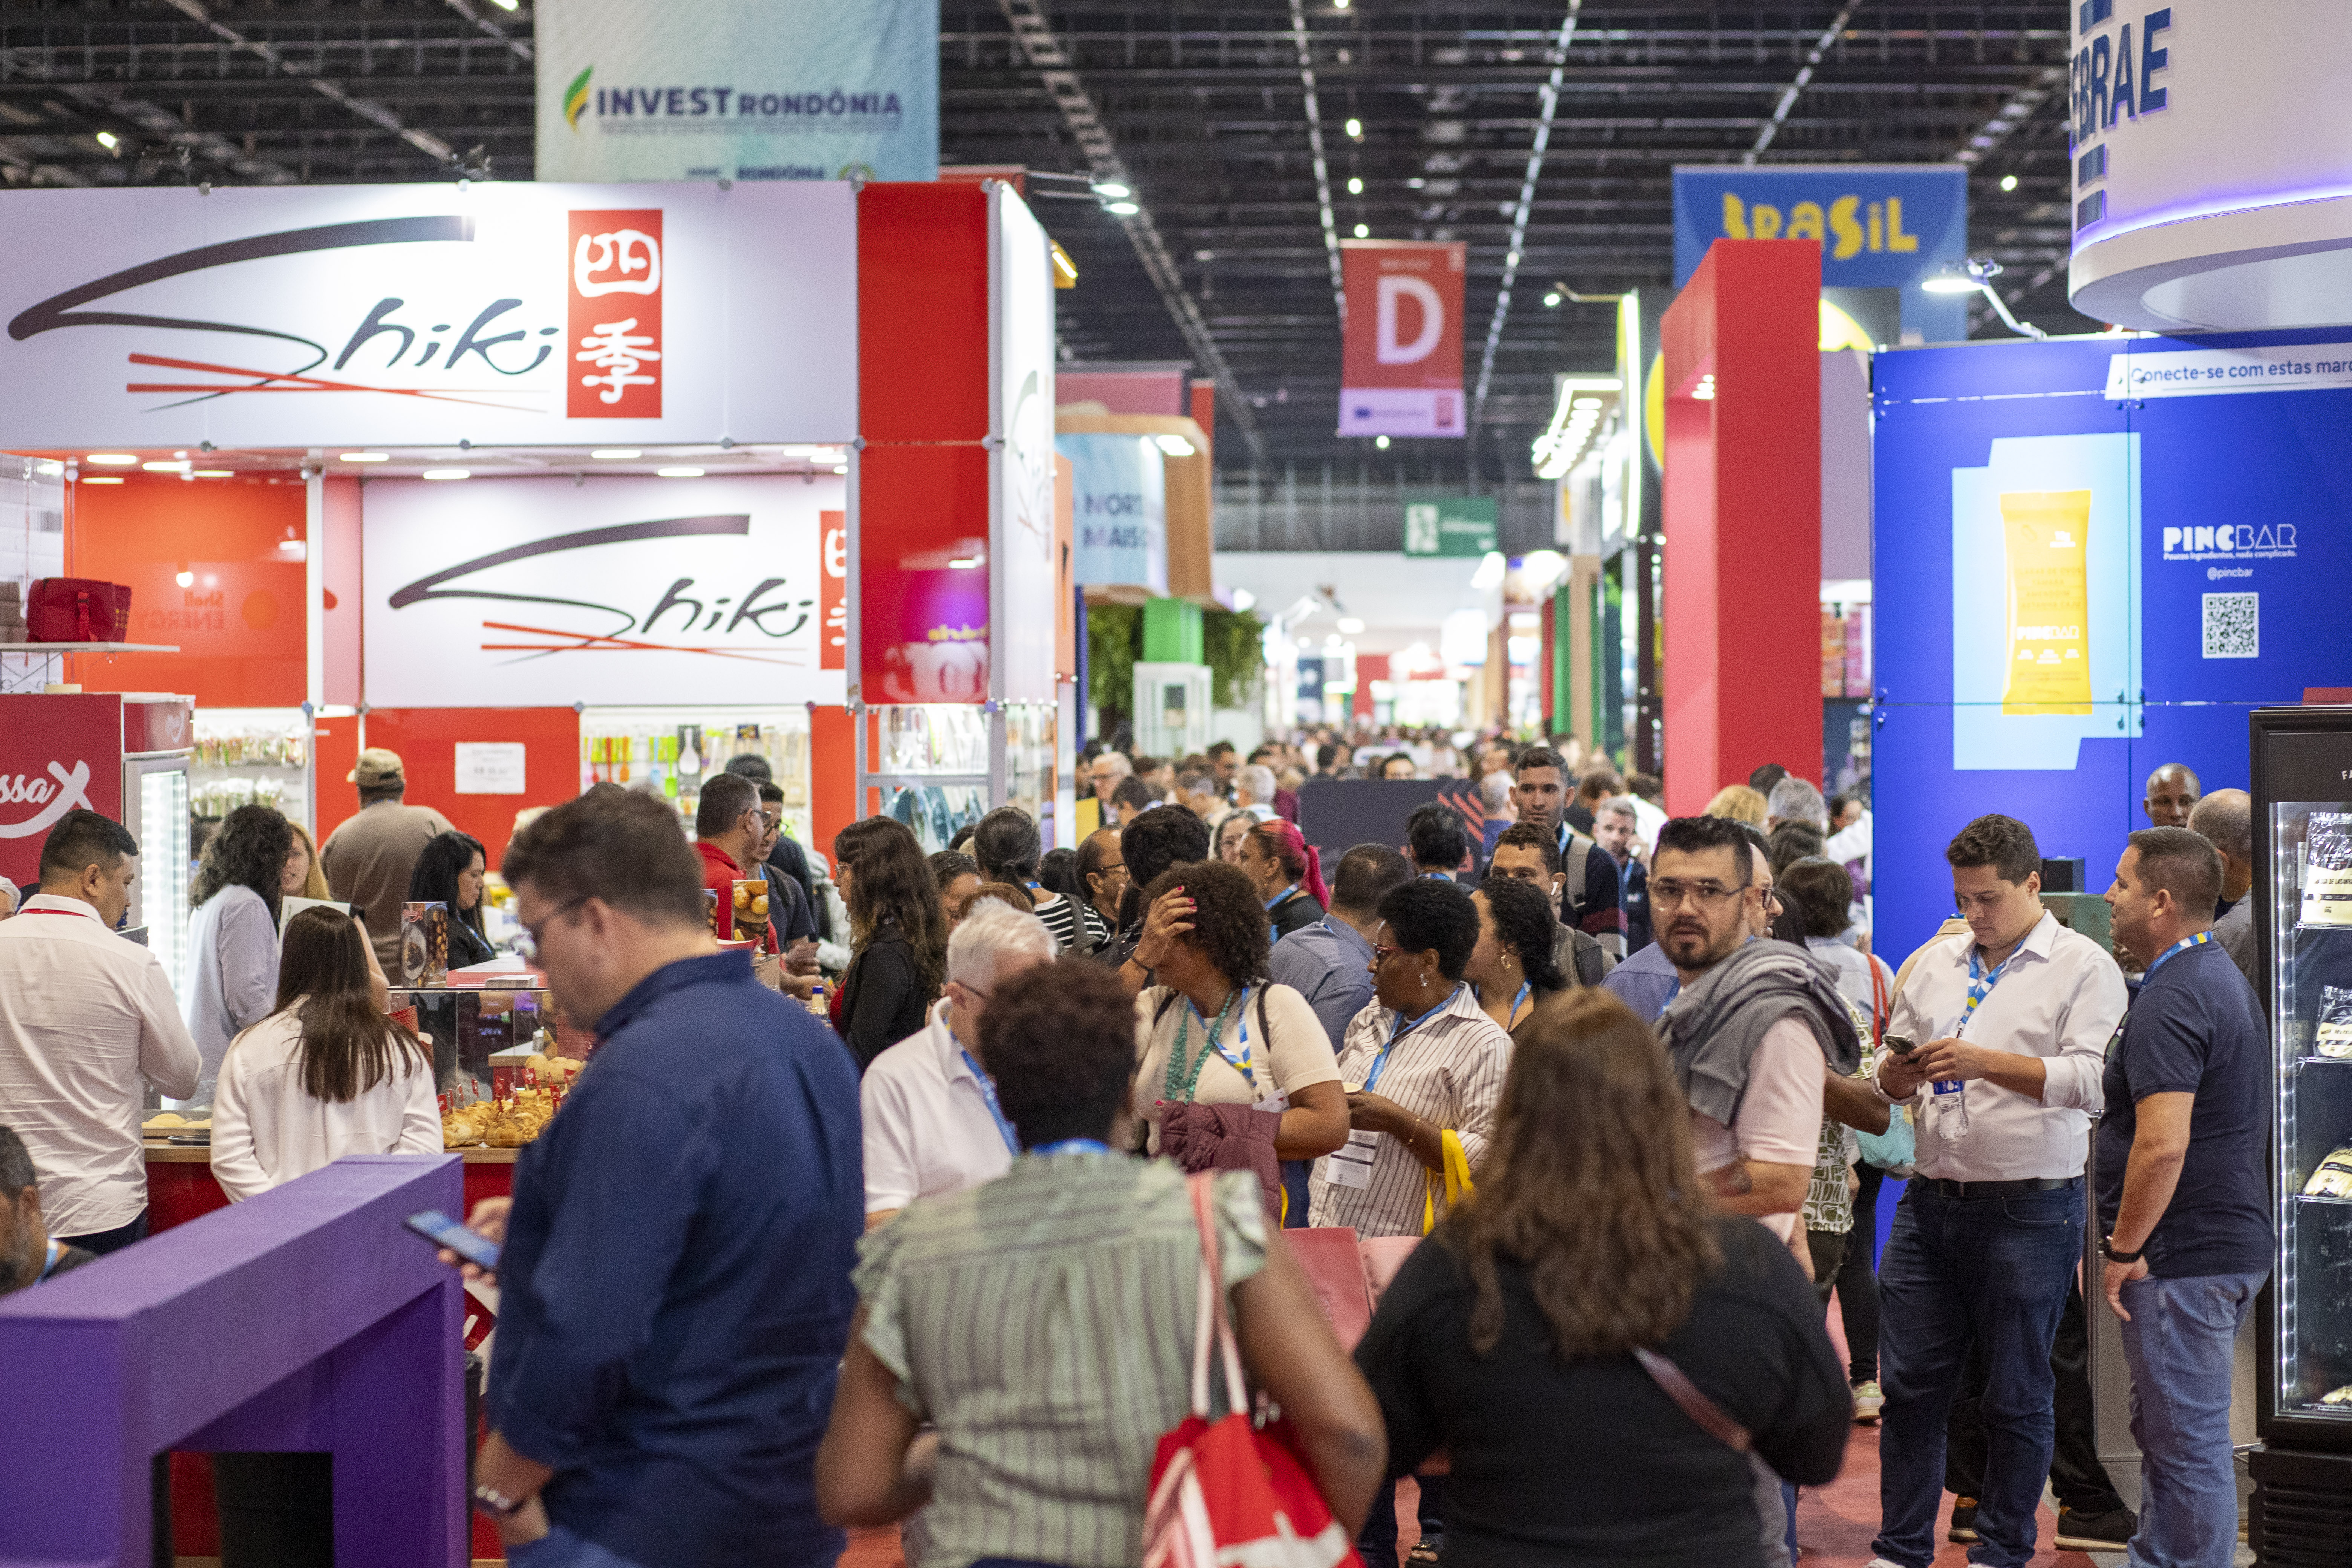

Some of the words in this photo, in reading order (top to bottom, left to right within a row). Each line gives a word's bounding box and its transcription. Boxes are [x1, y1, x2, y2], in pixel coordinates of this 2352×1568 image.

[597, 86, 733, 116] INVEST
[738, 86, 902, 116] RONDÔNIA
[8, 215, 560, 413] Shiki
[574, 228, 661, 405] 四季
[1377, 276, 1444, 364] D
[2132, 365, 2224, 381] Conecte-se
[2228, 364, 2264, 378] com
[2268, 360, 2312, 376] estas
[389, 514, 813, 666] Shiki
[2207, 567, 2254, 581] @pincbar
